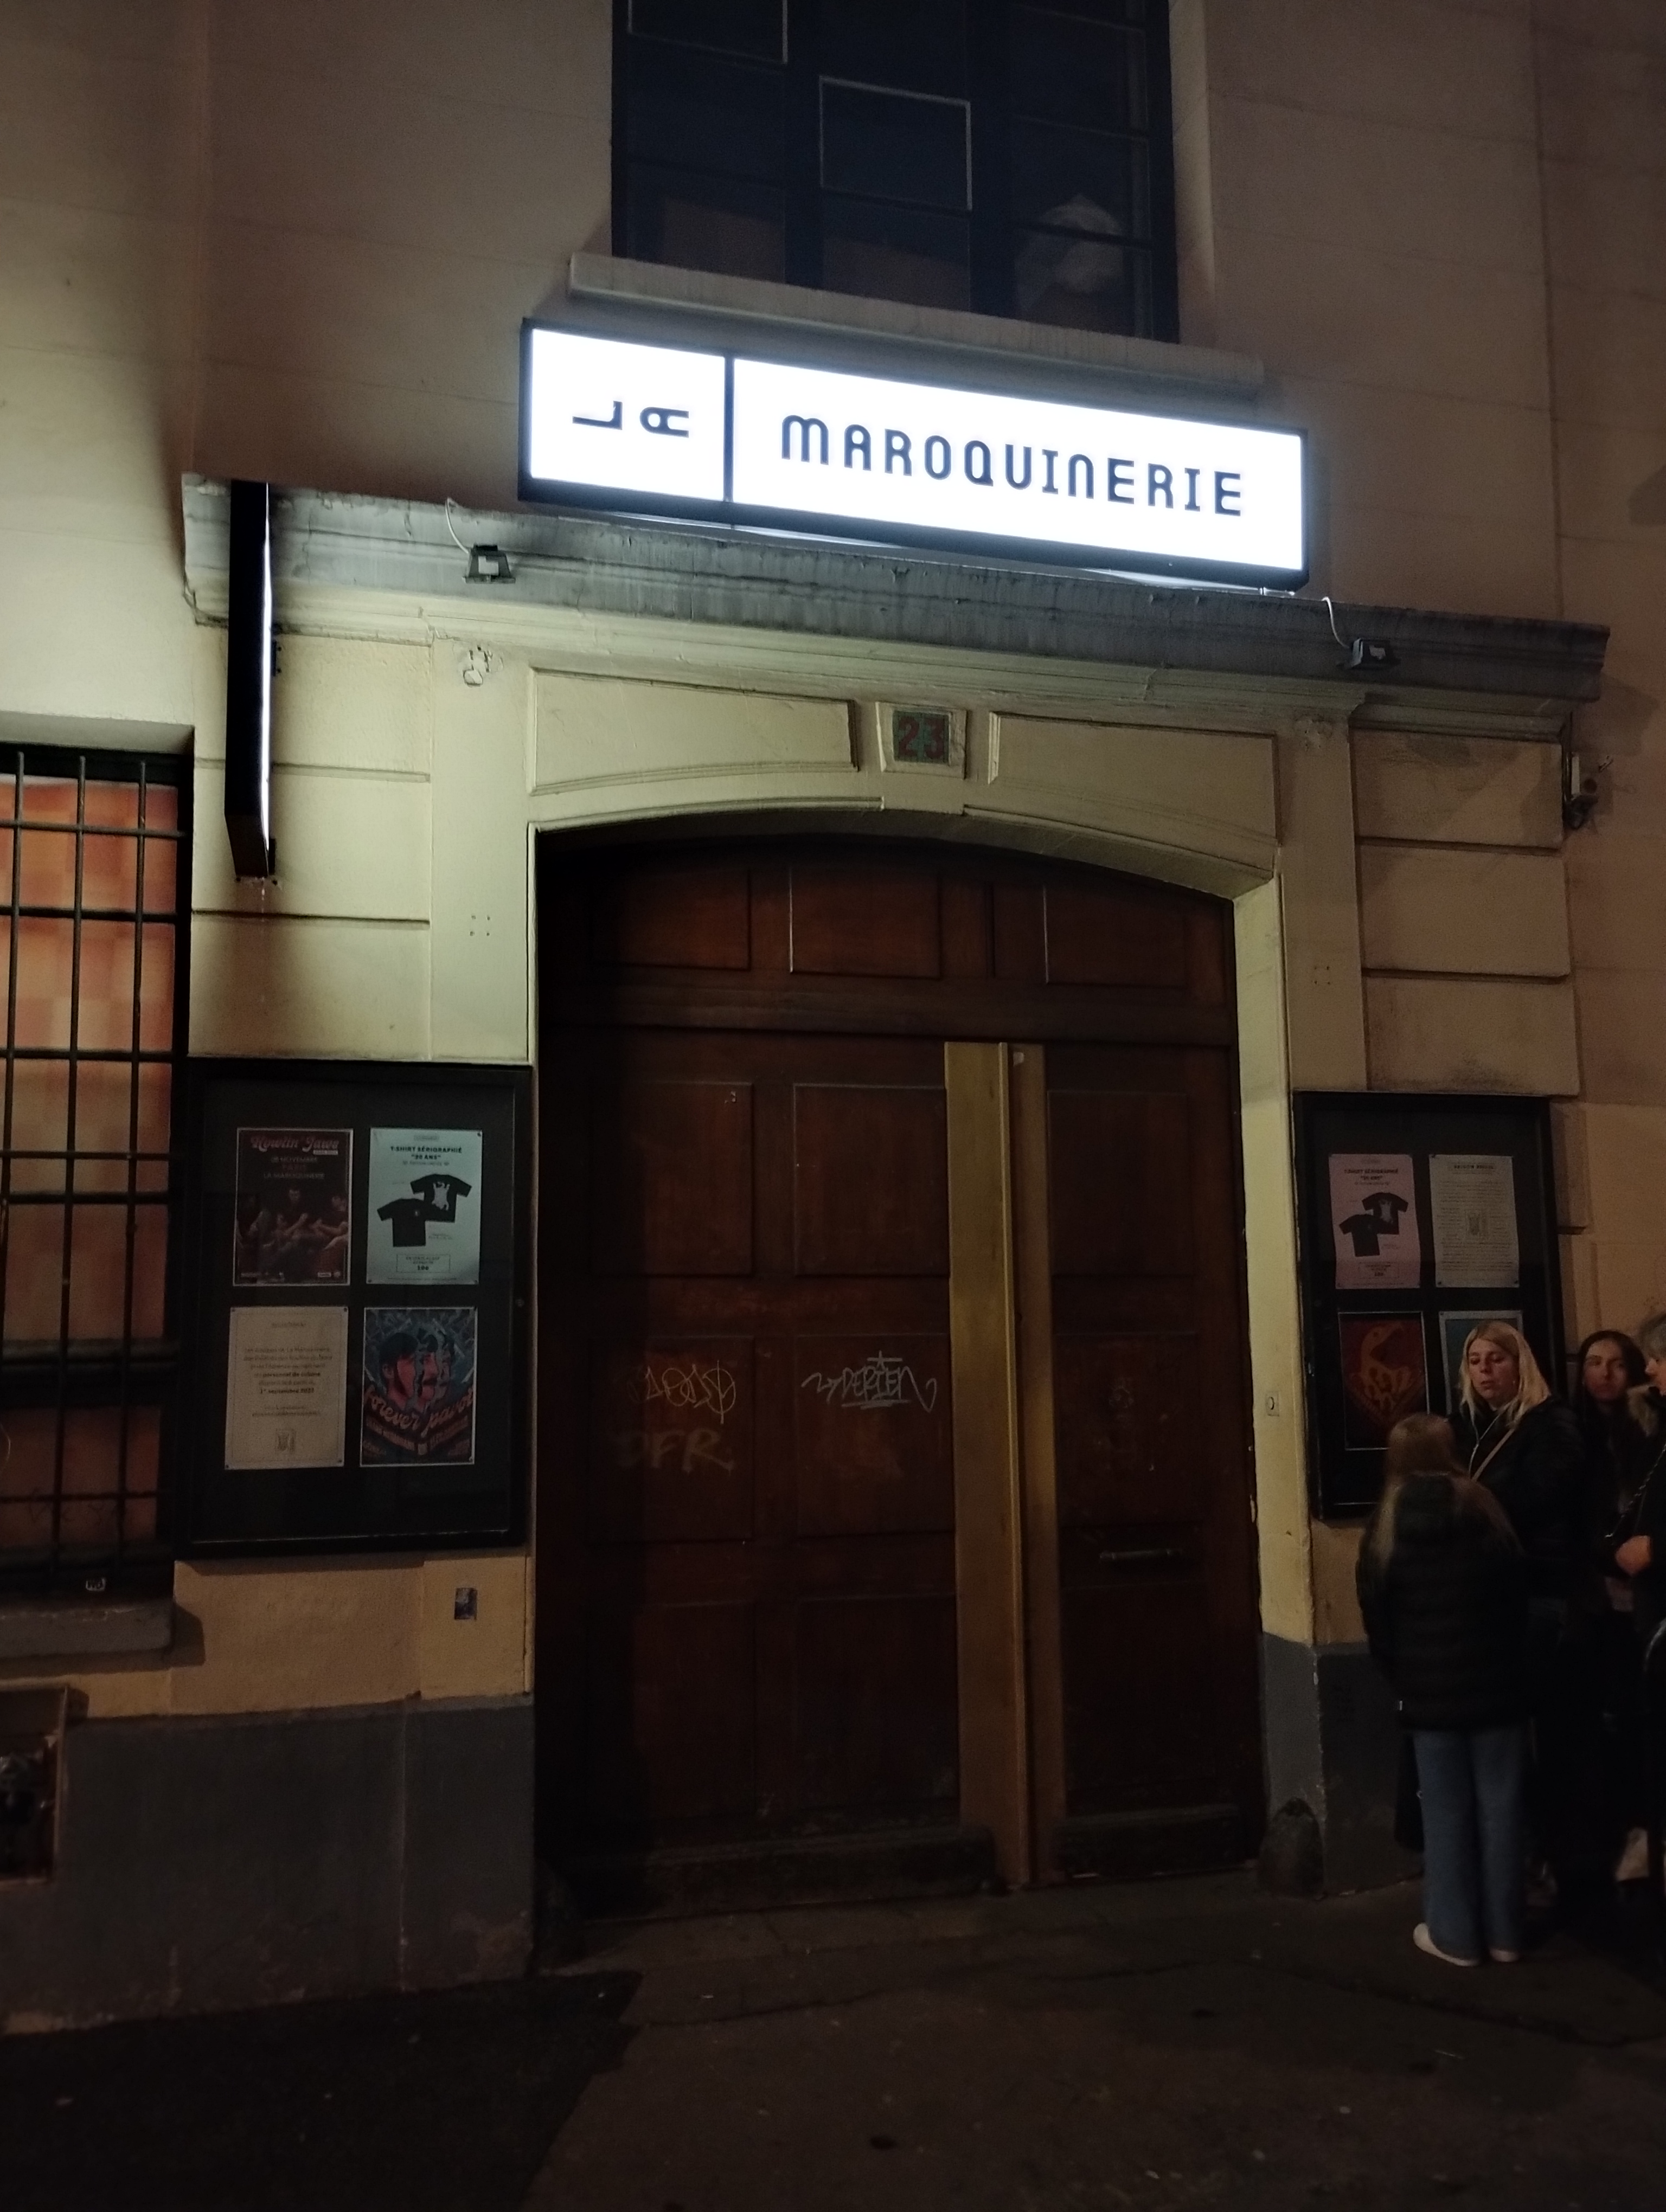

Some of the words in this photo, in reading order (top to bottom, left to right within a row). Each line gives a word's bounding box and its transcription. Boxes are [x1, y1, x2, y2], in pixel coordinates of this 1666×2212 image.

[572, 400, 689, 438] LA
[781, 415, 1241, 516] MAROQUINERIE
[899, 716, 945, 759] 23
